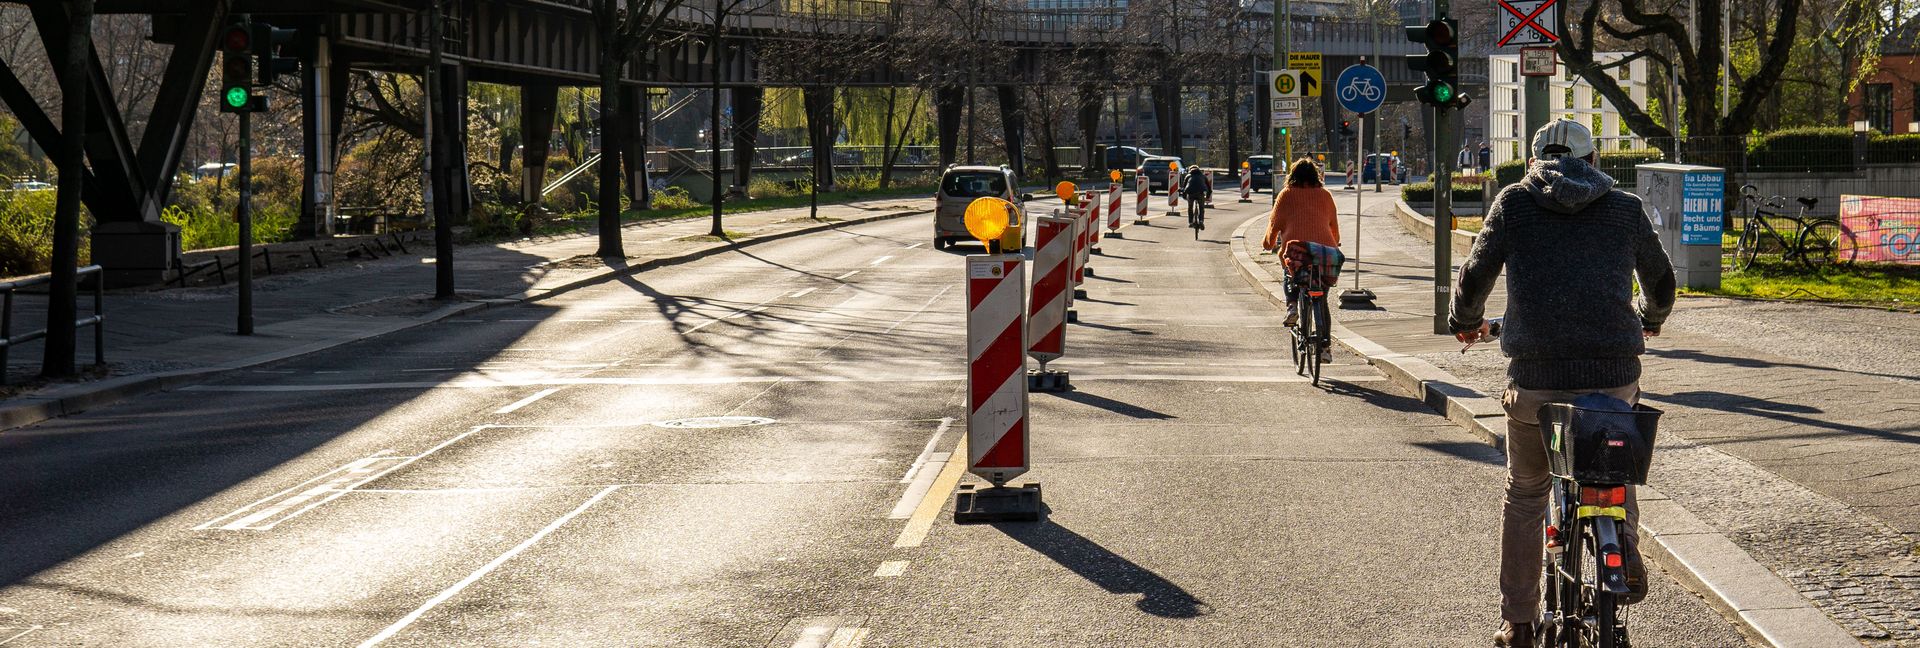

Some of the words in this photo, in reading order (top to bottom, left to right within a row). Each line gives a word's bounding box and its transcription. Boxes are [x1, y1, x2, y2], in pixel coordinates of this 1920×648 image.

[1280, 78, 1290, 90] H
[1706, 214, 1722, 222] und
[1694, 223, 1720, 232] Bäume
